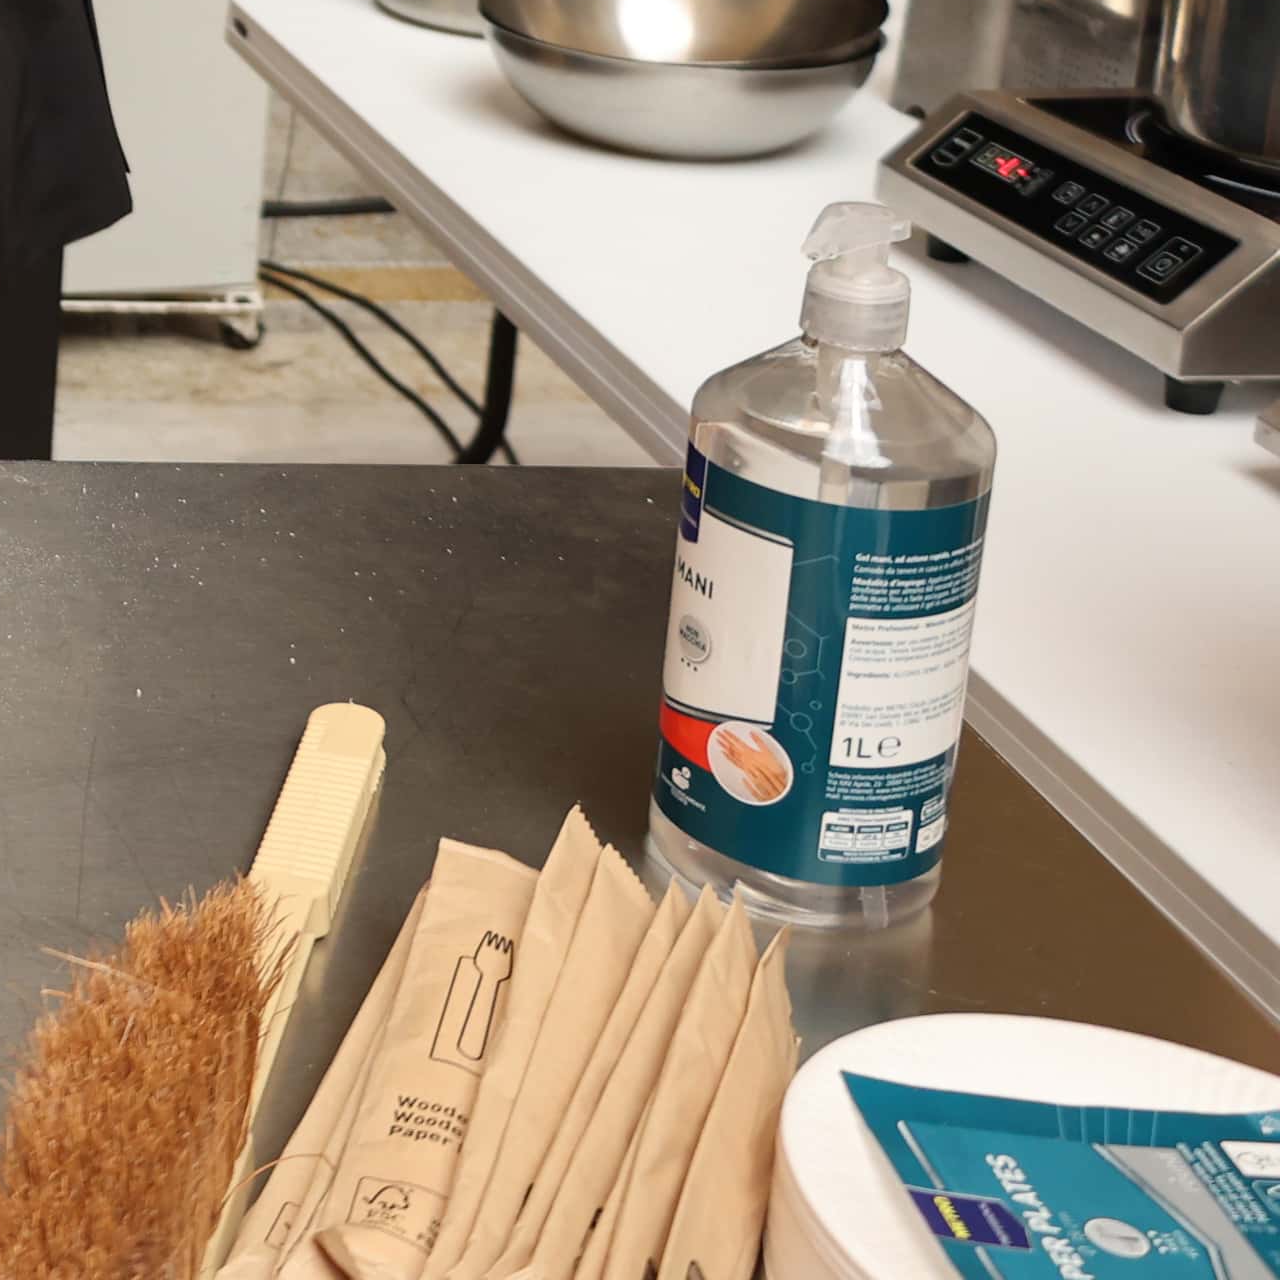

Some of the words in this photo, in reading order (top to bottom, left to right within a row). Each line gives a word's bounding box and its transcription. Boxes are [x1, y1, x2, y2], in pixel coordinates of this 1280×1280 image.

[842, 736, 872, 759] 1L
[388, 1125, 453, 1146] Paper
[985, 1152, 1063, 1235] PLATES
